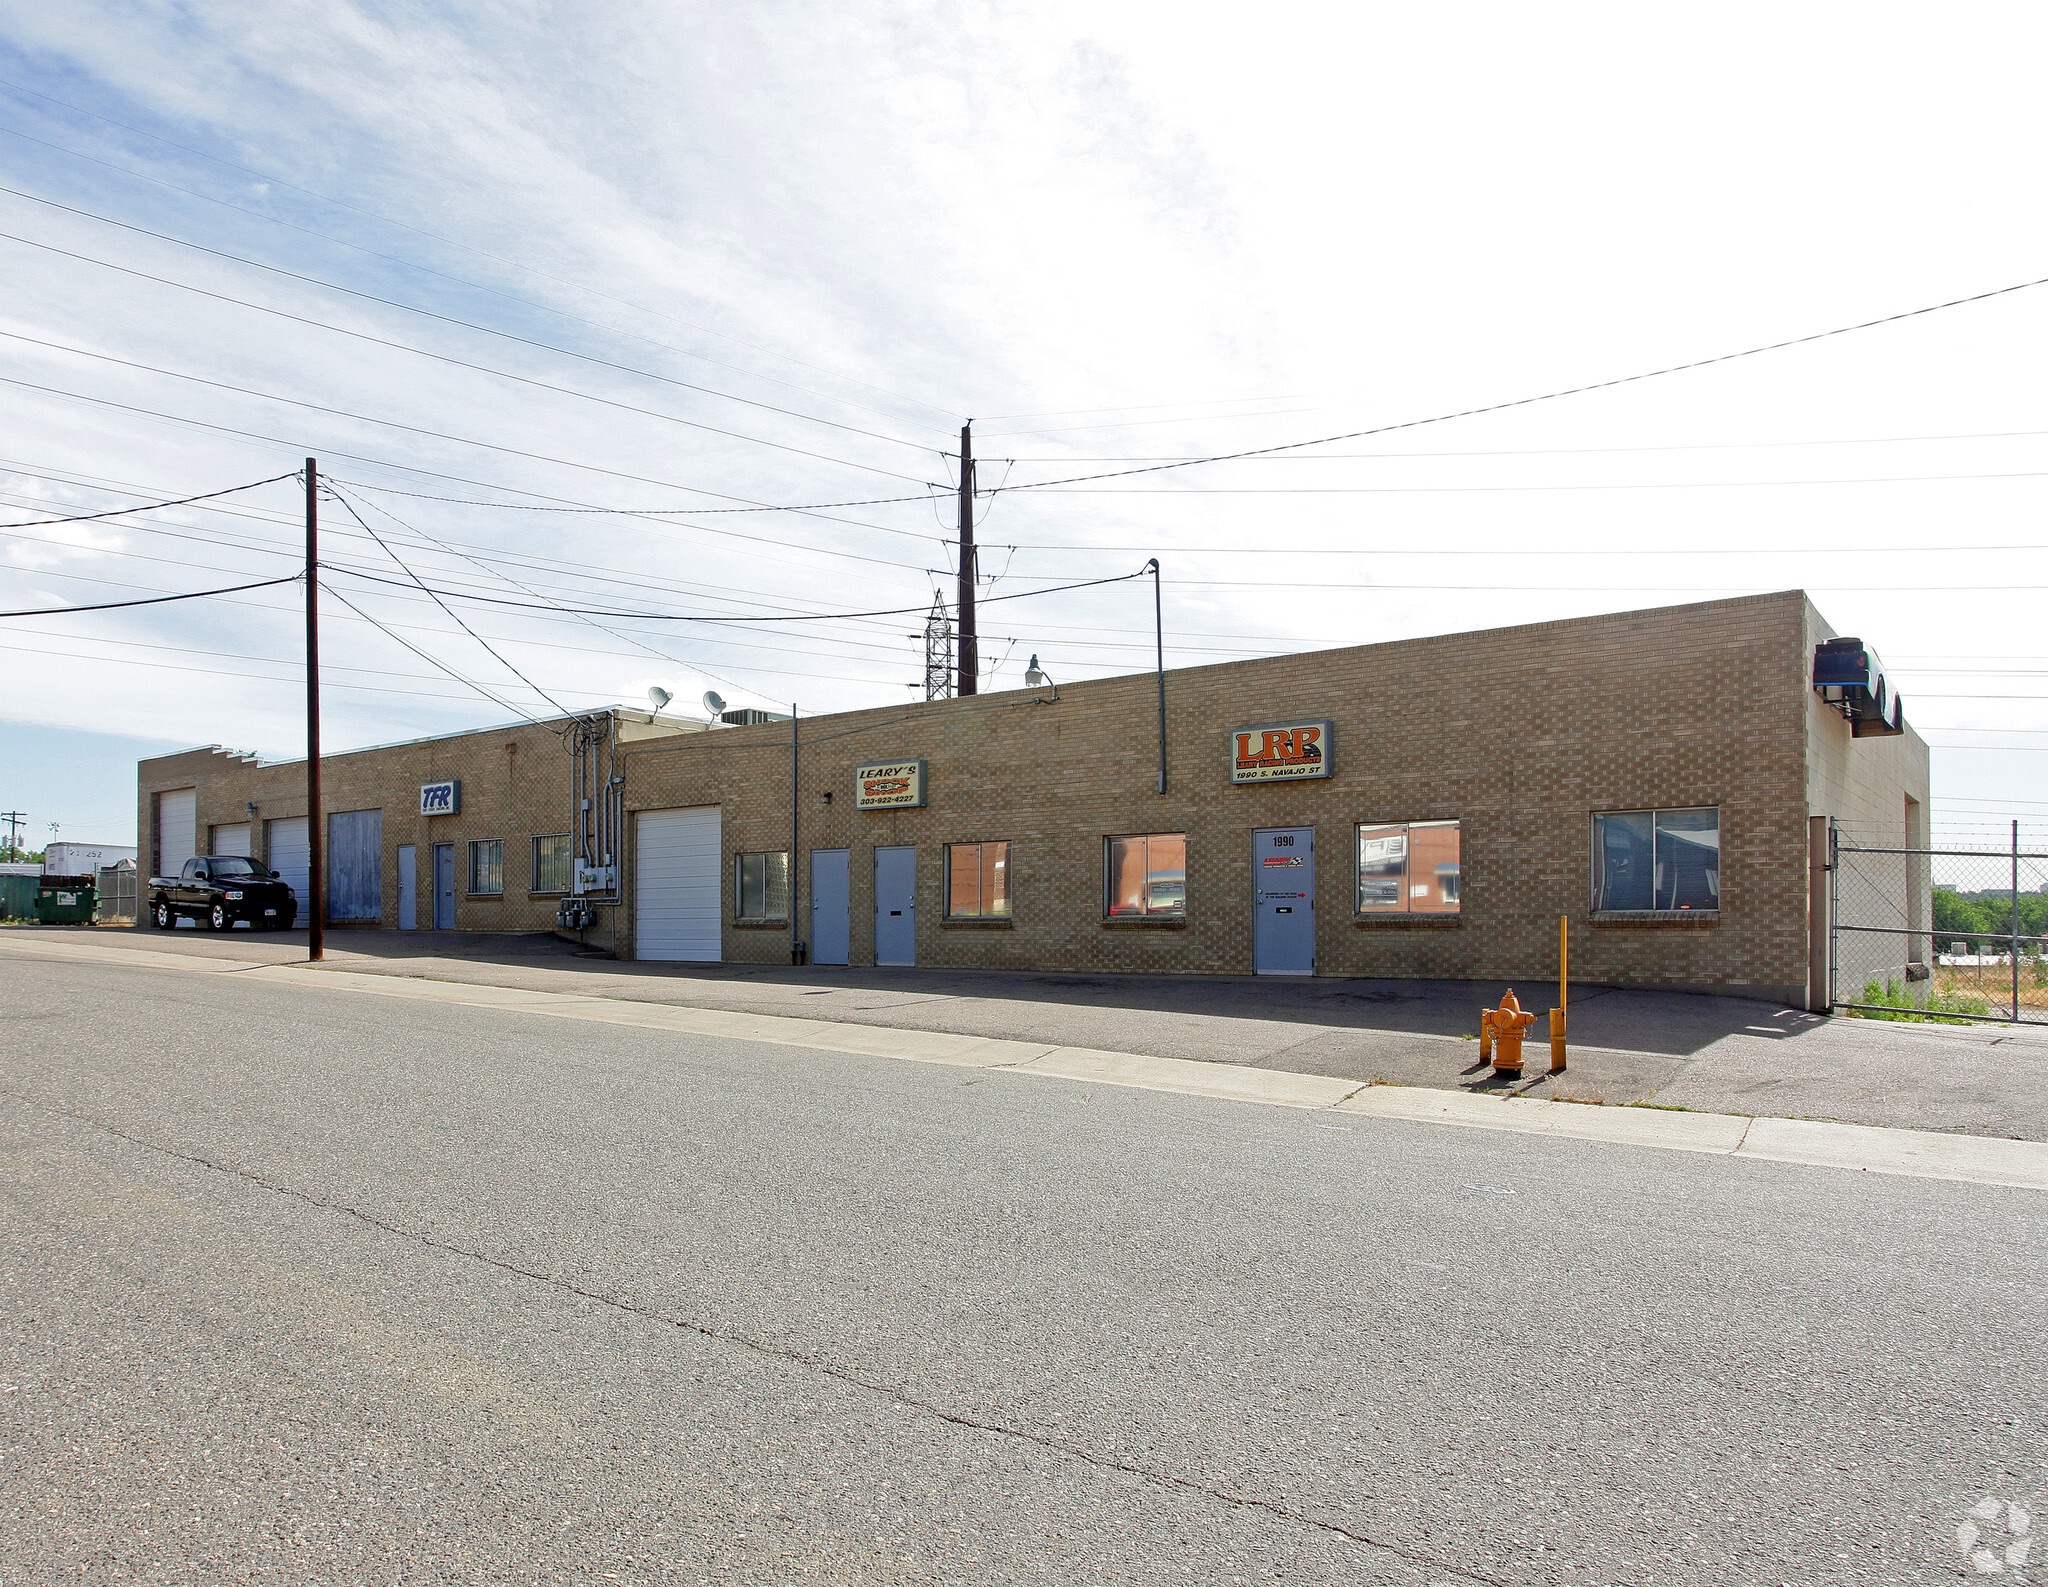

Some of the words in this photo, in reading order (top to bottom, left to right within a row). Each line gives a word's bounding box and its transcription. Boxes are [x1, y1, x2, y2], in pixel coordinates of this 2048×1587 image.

[1236, 727, 1320, 762] LRP
[1259, 759, 1283, 768] RACING
[1285, 756, 1321, 766] PRODUCTS
[859, 766, 916, 779] LEARY'S
[1236, 771, 1257, 779] 1990
[1272, 767, 1306, 776] NAVAJO
[423, 785, 451, 808] TFR
[860, 795, 914, 805] 303-922-4227
[1273, 836, 1294, 847] 1990
